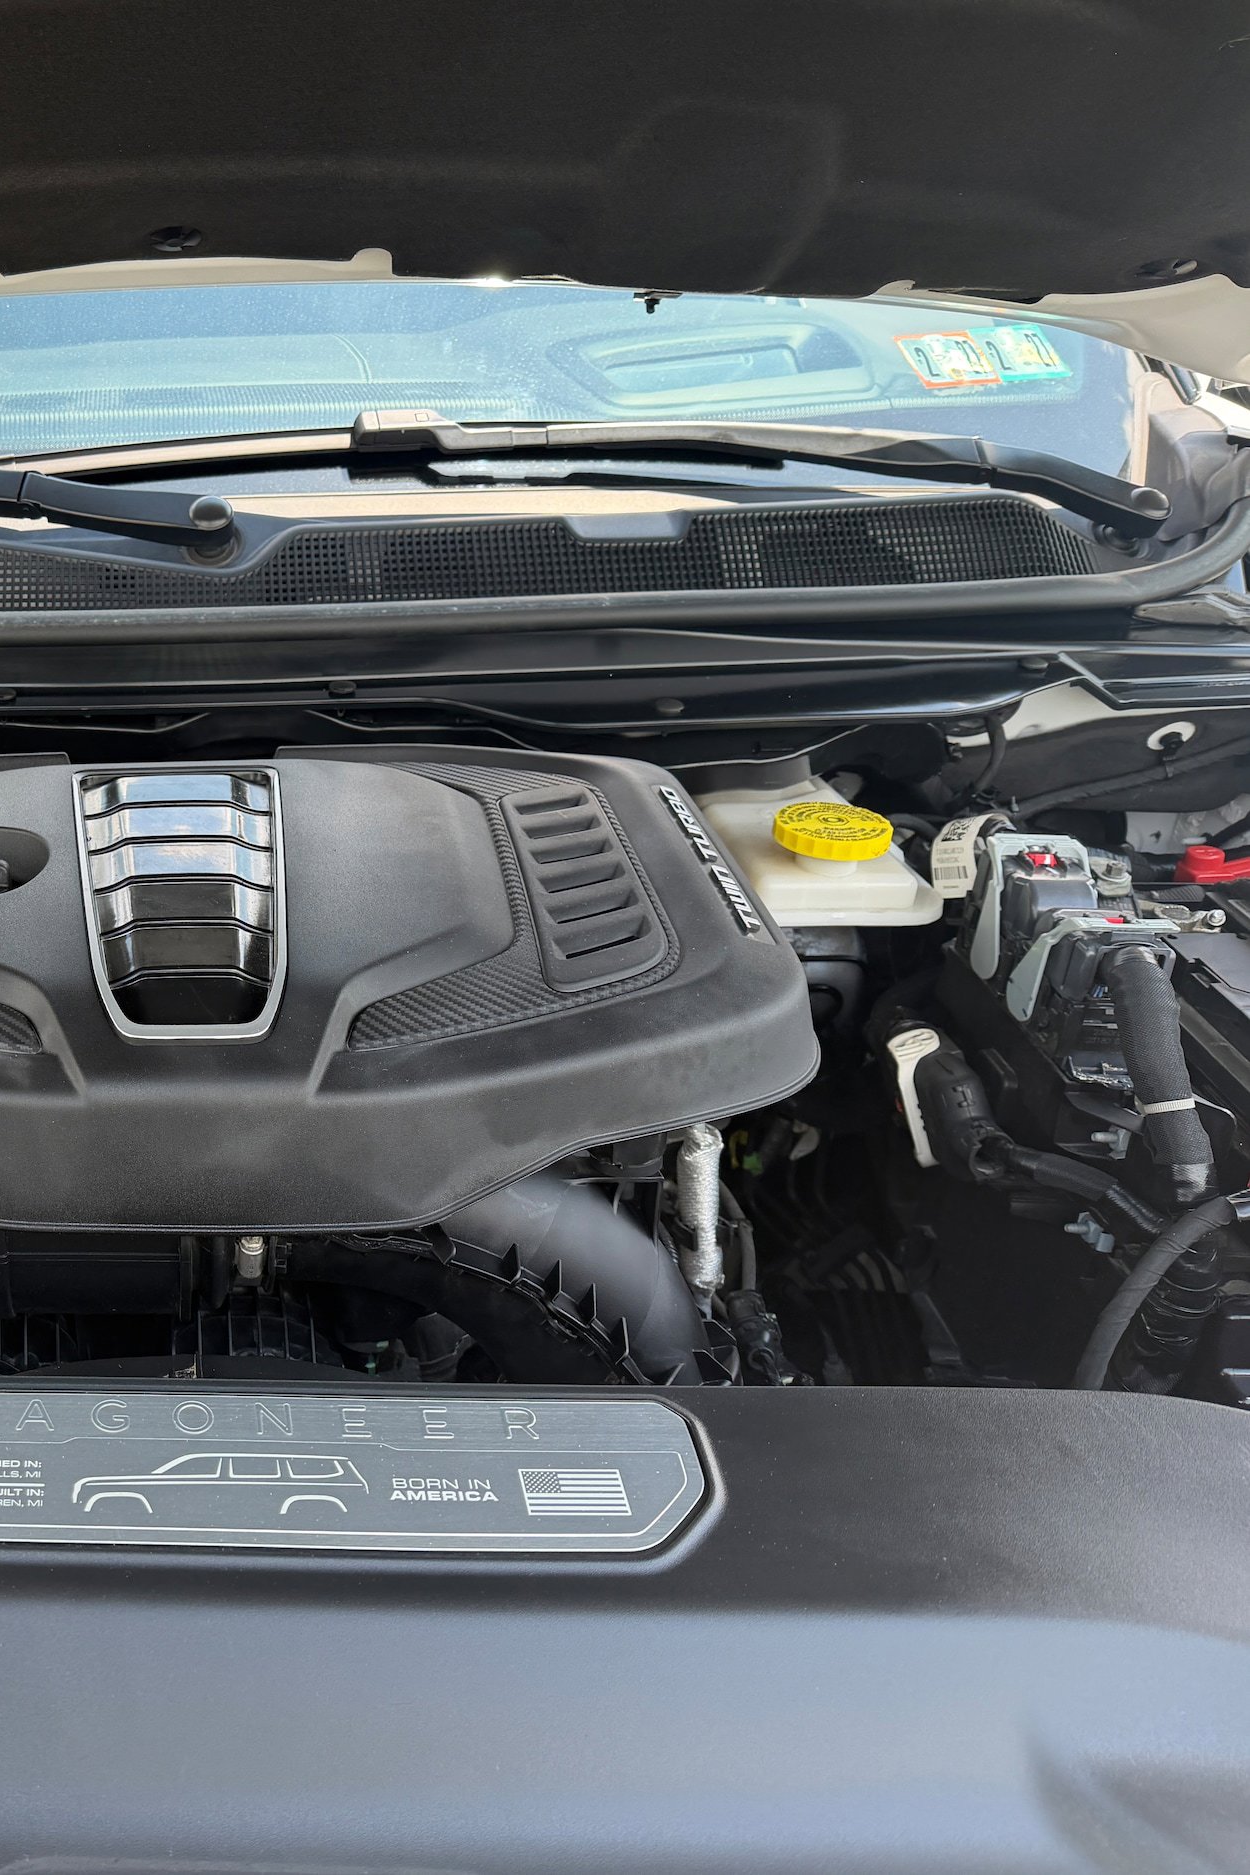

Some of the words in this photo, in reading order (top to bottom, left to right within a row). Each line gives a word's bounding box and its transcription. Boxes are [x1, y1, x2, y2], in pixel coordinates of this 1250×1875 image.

[913, 346, 941, 377] 2
[985, 340, 1013, 371] 2
[659, 785, 718, 862] TURBO
[710, 864, 761, 931] TWIN
[23, 1459, 43, 1469] IN:
[25, 1471, 41, 1479] MI
[392, 1478, 459, 1490] BORN
[468, 1479, 492, 1490] IN
[26, 1488, 45, 1497] IN:
[390, 1490, 500, 1502] AMERICA
[27, 1499, 44, 1507] MI
